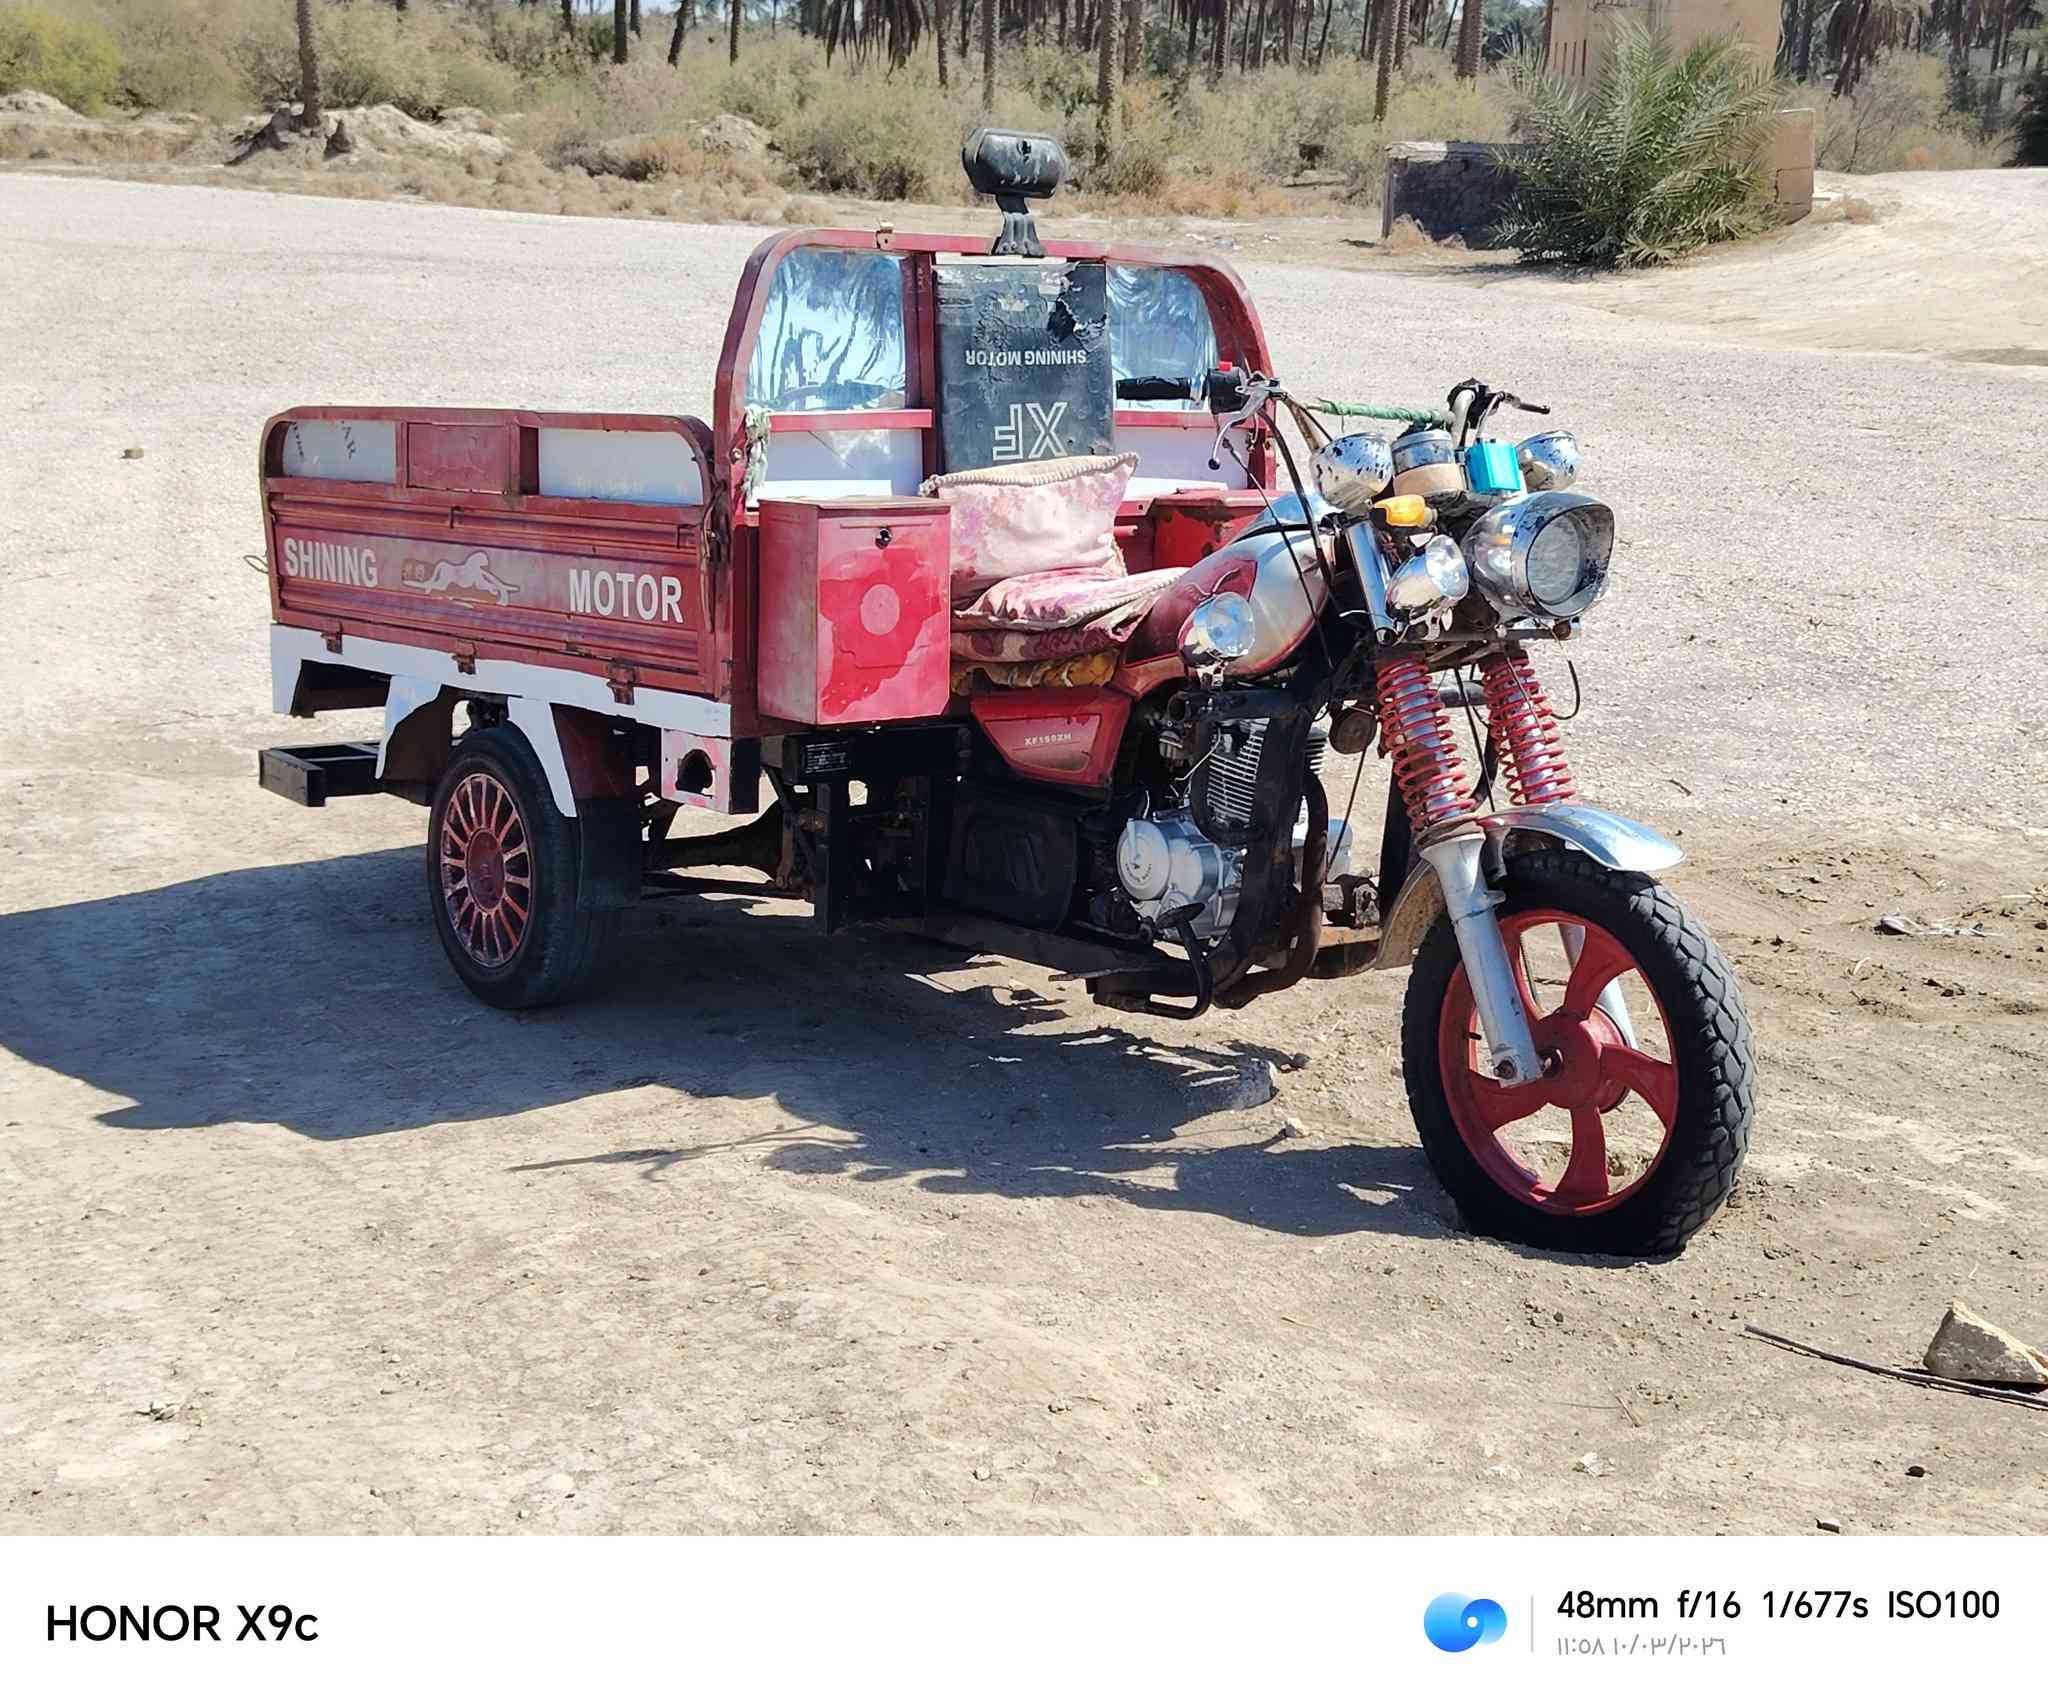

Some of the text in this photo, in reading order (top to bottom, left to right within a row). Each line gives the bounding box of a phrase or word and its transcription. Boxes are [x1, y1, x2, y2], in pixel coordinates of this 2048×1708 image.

[965, 349, 1087, 367] SHINING MOTOR
[992, 401, 1068, 460] XF
[283, 537, 683, 624] SHINING MOTOR
